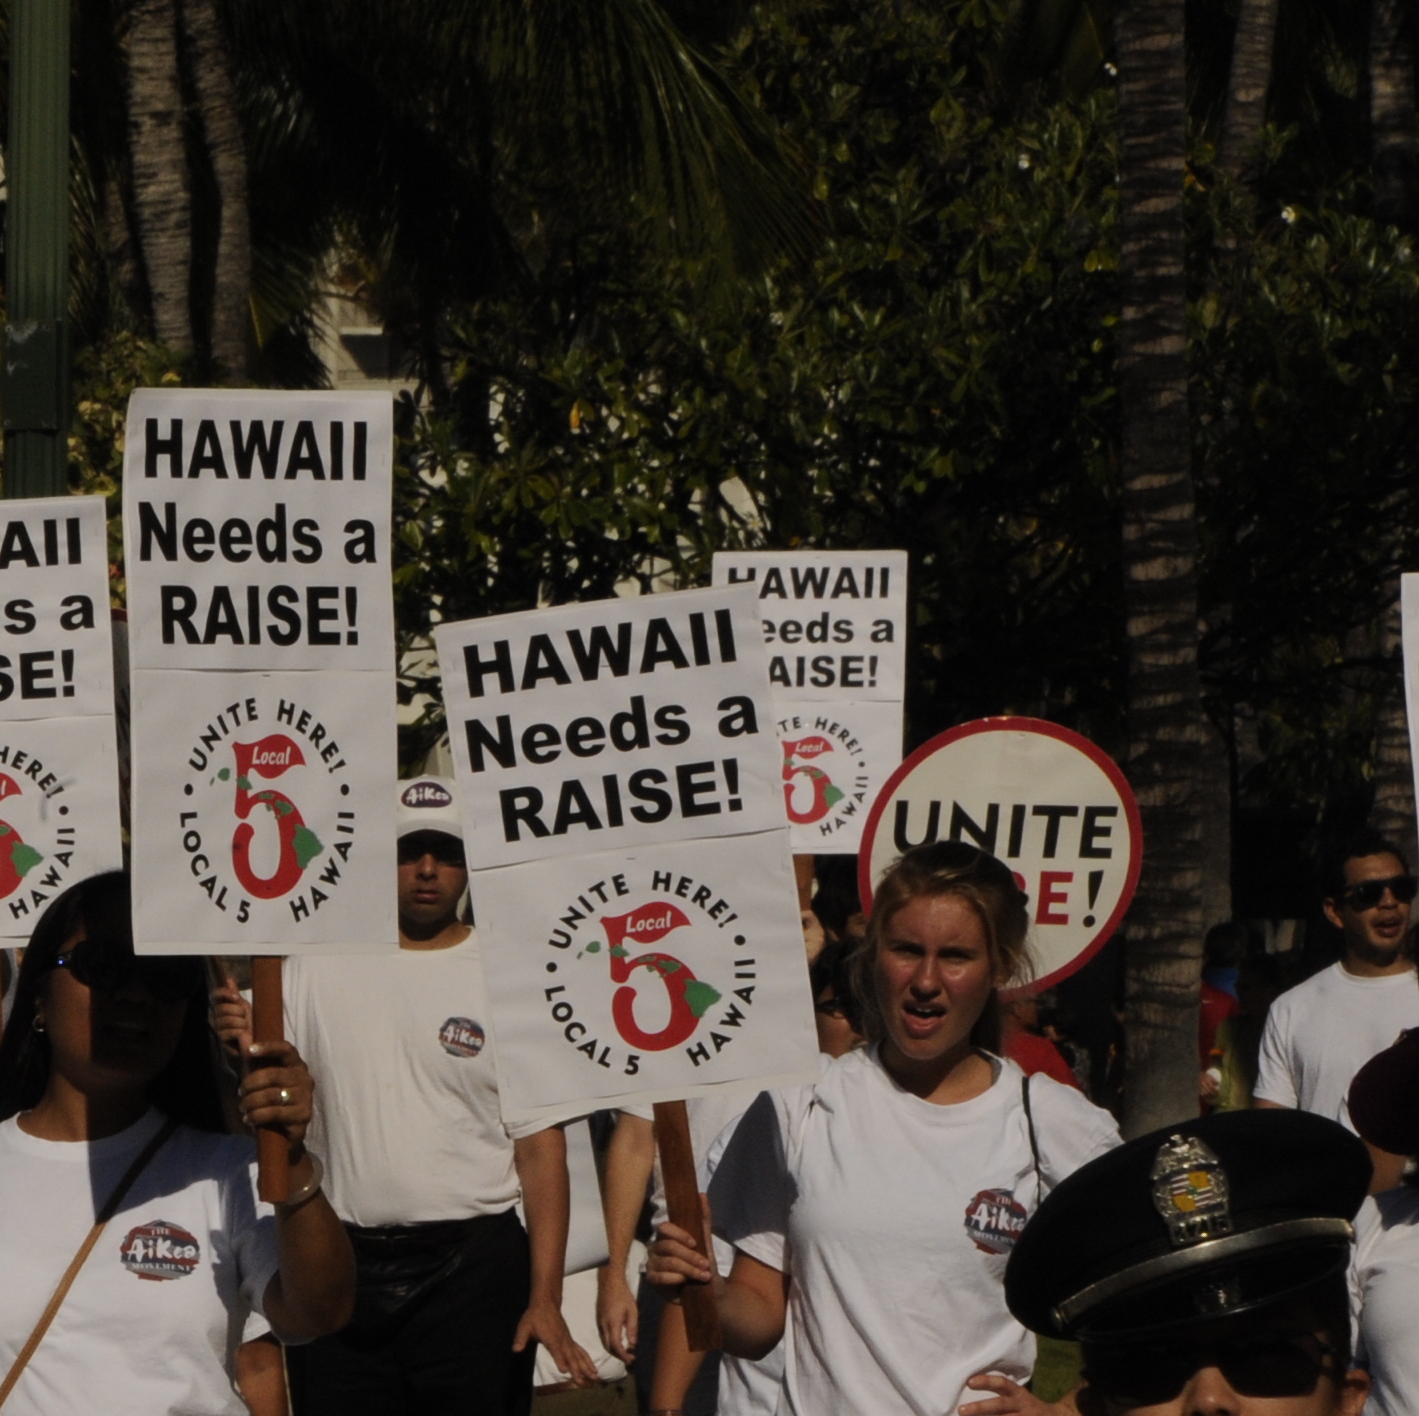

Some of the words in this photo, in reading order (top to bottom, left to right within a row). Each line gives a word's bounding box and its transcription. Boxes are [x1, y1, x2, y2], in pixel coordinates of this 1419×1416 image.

[145, 418, 367, 480] HAWAII
[139, 502, 322, 563] Needs
[344, 519, 376, 564] a
[60, 595, 94, 630] a
[161, 585, 358, 646] RAISE!
[763, 612, 853, 643] eeds
[871, 620, 893, 642] a
[463, 609, 736, 698] HAWAII
[770, 656, 878, 687] AISE!
[189, 698, 258, 771] UNITE
[277, 699, 345, 773] HERE!
[251, 744, 291, 766] Local
[465, 695, 690, 772] Needs
[717, 696, 758, 737] a
[795, 740, 824, 754] Local
[815, 717, 862, 756] HERE!
[232, 733, 307, 900] 5
[499, 758, 743, 842] RAISE!
[820, 775, 869, 837] HAWAII
[894, 800, 1118, 859] UNITE
[9, 828, 83, 927] HAWAII
[180, 812, 227, 911] LOCAL
[237, 900, 250, 923] 5
[290, 812, 354, 922] HAWAII
[549, 874, 629, 953] UNITE
[652, 871, 737, 927] HERE!
[625, 911, 673, 936] Local
[600, 901, 700, 1052] 5
[545, 986, 610, 1068] LOCAL
[625, 1055, 639, 1075] 5
[684, 959, 755, 1066] HAWAII
